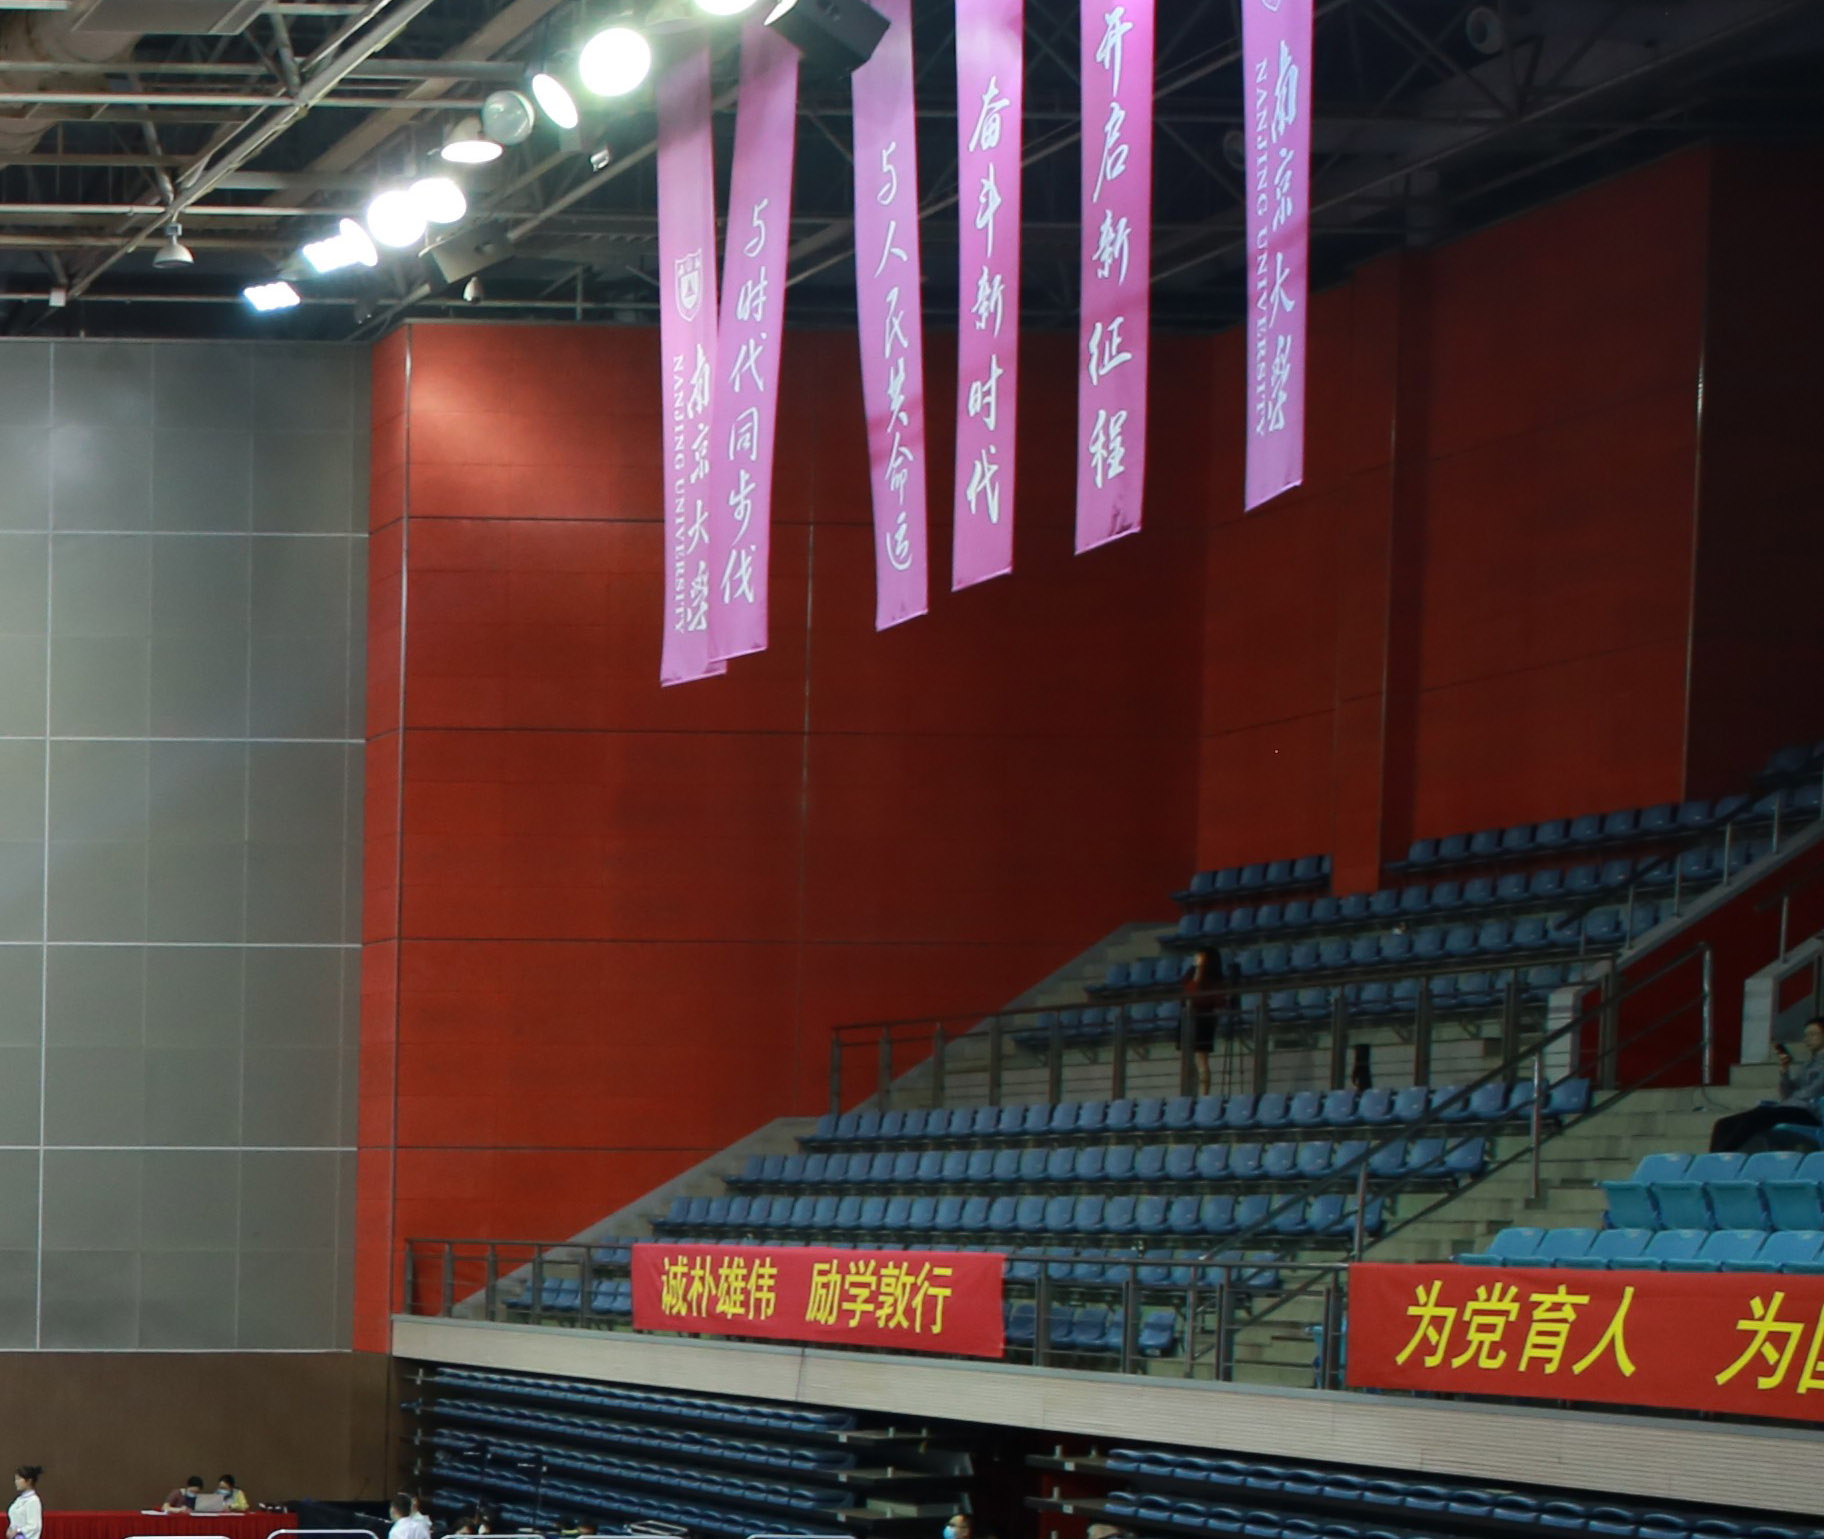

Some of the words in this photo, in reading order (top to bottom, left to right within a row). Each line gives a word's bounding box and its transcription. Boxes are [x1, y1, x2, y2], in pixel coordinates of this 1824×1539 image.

[1088, 6, 1131, 488] 开启新征程
[1255, 58, 1269, 218] NANJING
[673, 353, 686, 473] NANJING
[721, 198, 769, 605] 与时代同步伐
[874, 141, 913, 571] 与人民共命运
[966, 76, 1011, 525] 奋斗新时代
[660, 1256, 778, 1321] 诚朴雄伟
[804, 1260, 953, 1335] 励学敦行
[1393, 1284, 1639, 1378] 为党育人
